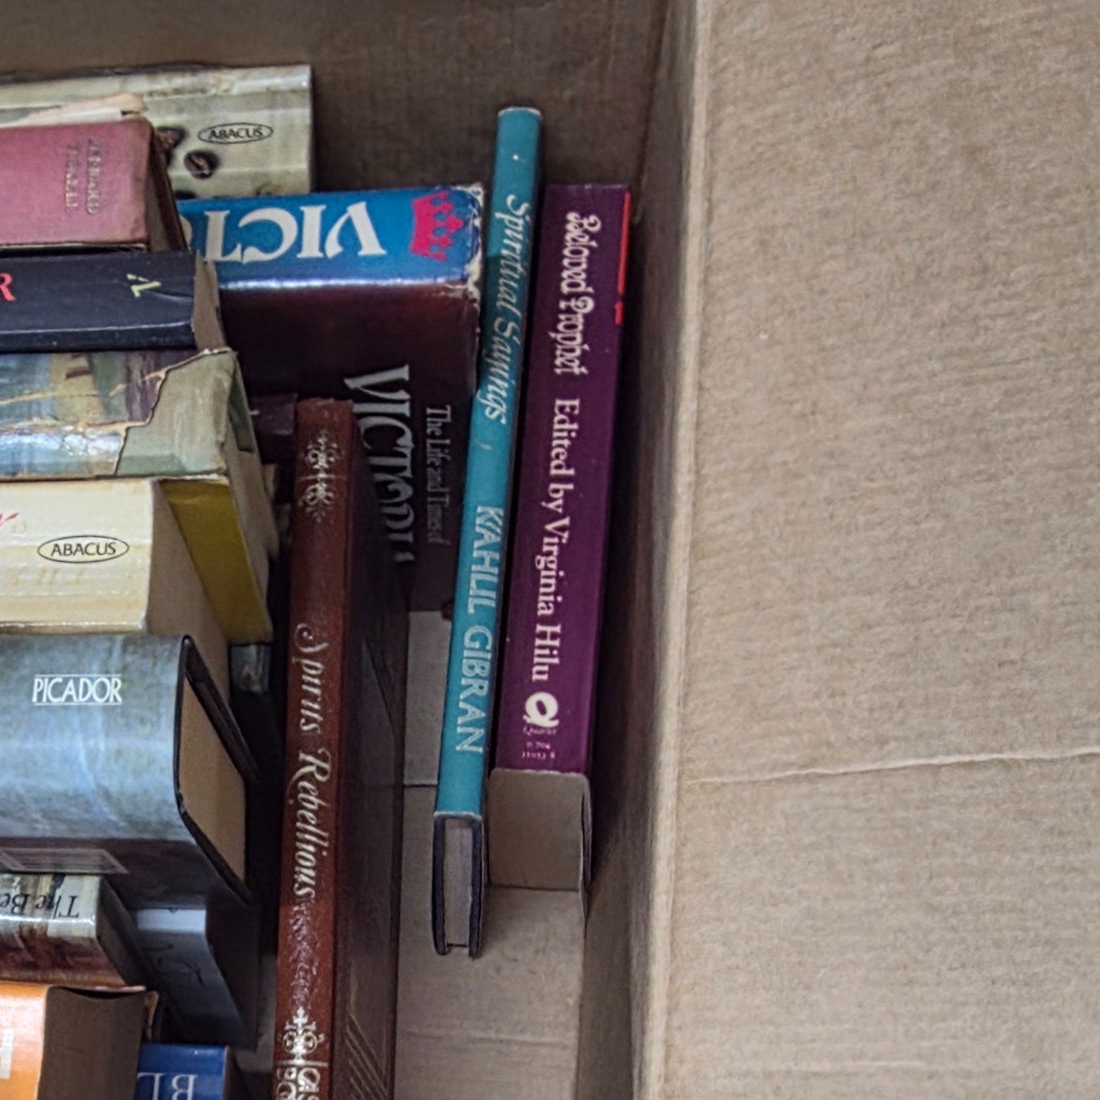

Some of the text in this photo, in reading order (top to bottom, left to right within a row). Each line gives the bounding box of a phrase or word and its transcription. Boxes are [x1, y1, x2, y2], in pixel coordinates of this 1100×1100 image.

[208, 125, 264, 140] ABACUS
[184, 201, 388, 264] VICT
[476, 193, 531, 425] Spiritual Sayings
[426, 405, 452, 435] The
[427, 437, 452, 465] Life
[531, 211, 602, 684] Beloved Prophet Edited by Virginia Hilu
[50, 540, 118, 559] ABACUS
[455, 504, 504, 754] KAHLIL GIBRAN
[31, 676, 124, 705] PICADOR
[285, 745, 333, 899] Rebellious
[35, 894, 81, 919] The
